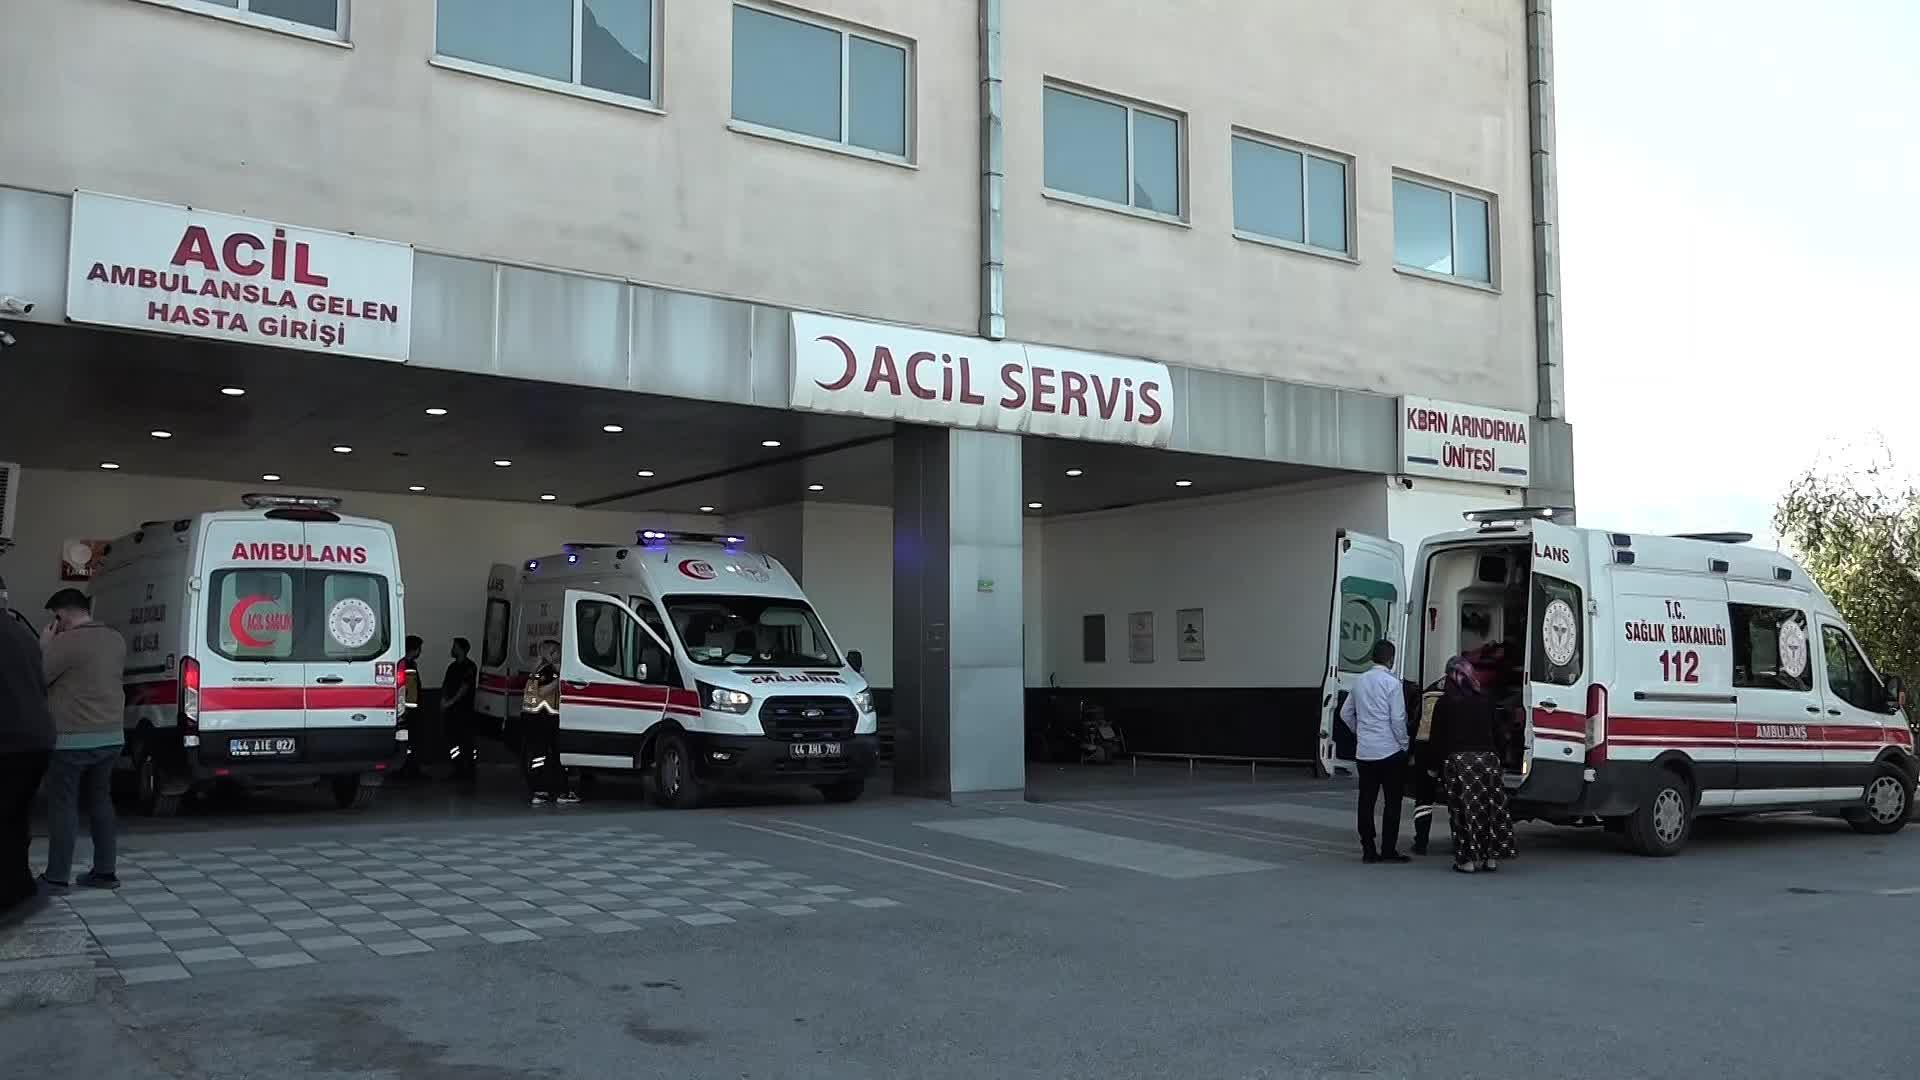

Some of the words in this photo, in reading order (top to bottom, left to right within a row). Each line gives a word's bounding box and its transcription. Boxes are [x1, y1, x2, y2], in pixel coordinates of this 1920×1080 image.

[170, 225, 329, 288] ACİL
[86, 262, 298, 309] AMBULANSLA
[306, 293, 398, 323] GELEN
[148, 301, 249, 332] HASTA
[258, 315, 346, 348] GİRİŞİ
[863, 345, 985, 406] ACİL
[999, 362, 1164, 425] SERVİS
[1407, 407, 1448, 434] KBRN
[1451, 414, 1527, 444] ARINDIRMA
[231, 541, 368, 564] AMBULANS
[1534, 541, 1570, 564] LANS
[1664, 599, 1686, 620] T.C.
[1625, 619, 1666, 643] SAĞLIK
[1671, 623, 1727, 646] BAKANLIĞI
[377, 664, 393, 676] 112
[1659, 649, 1699, 682] 112
[1756, 724, 1807, 740] AMBULANS
